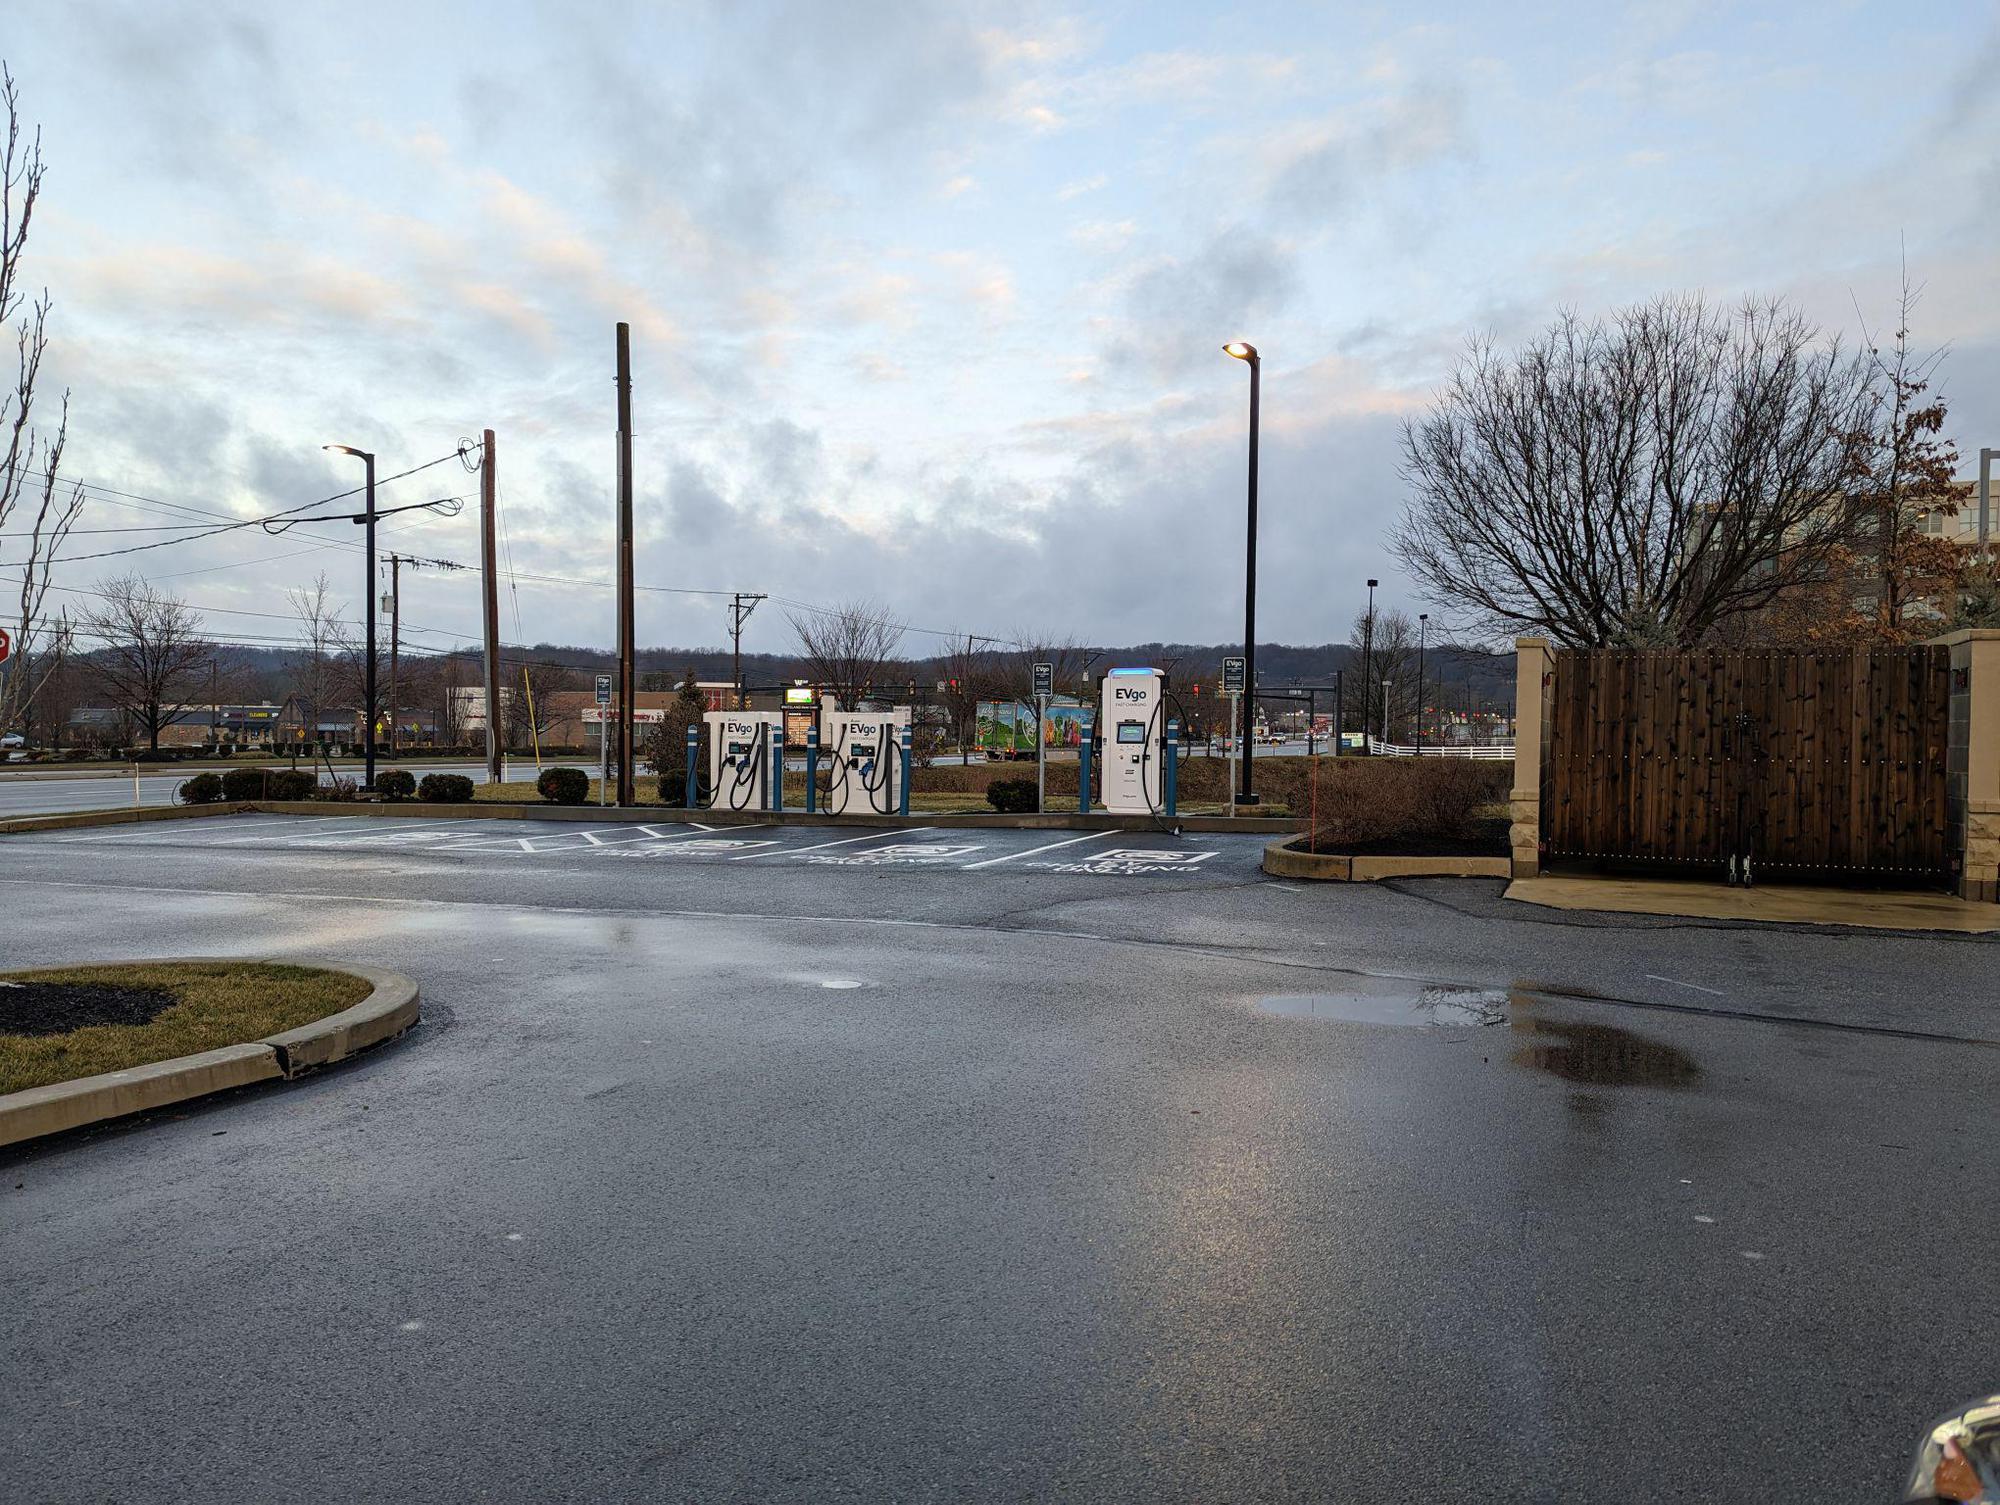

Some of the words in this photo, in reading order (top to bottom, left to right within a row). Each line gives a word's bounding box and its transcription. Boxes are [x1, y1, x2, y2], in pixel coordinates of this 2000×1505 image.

[1115, 688, 1147, 702] EVgo
[728, 723, 753, 735] EVgo
[850, 723, 876, 736] EVgo
